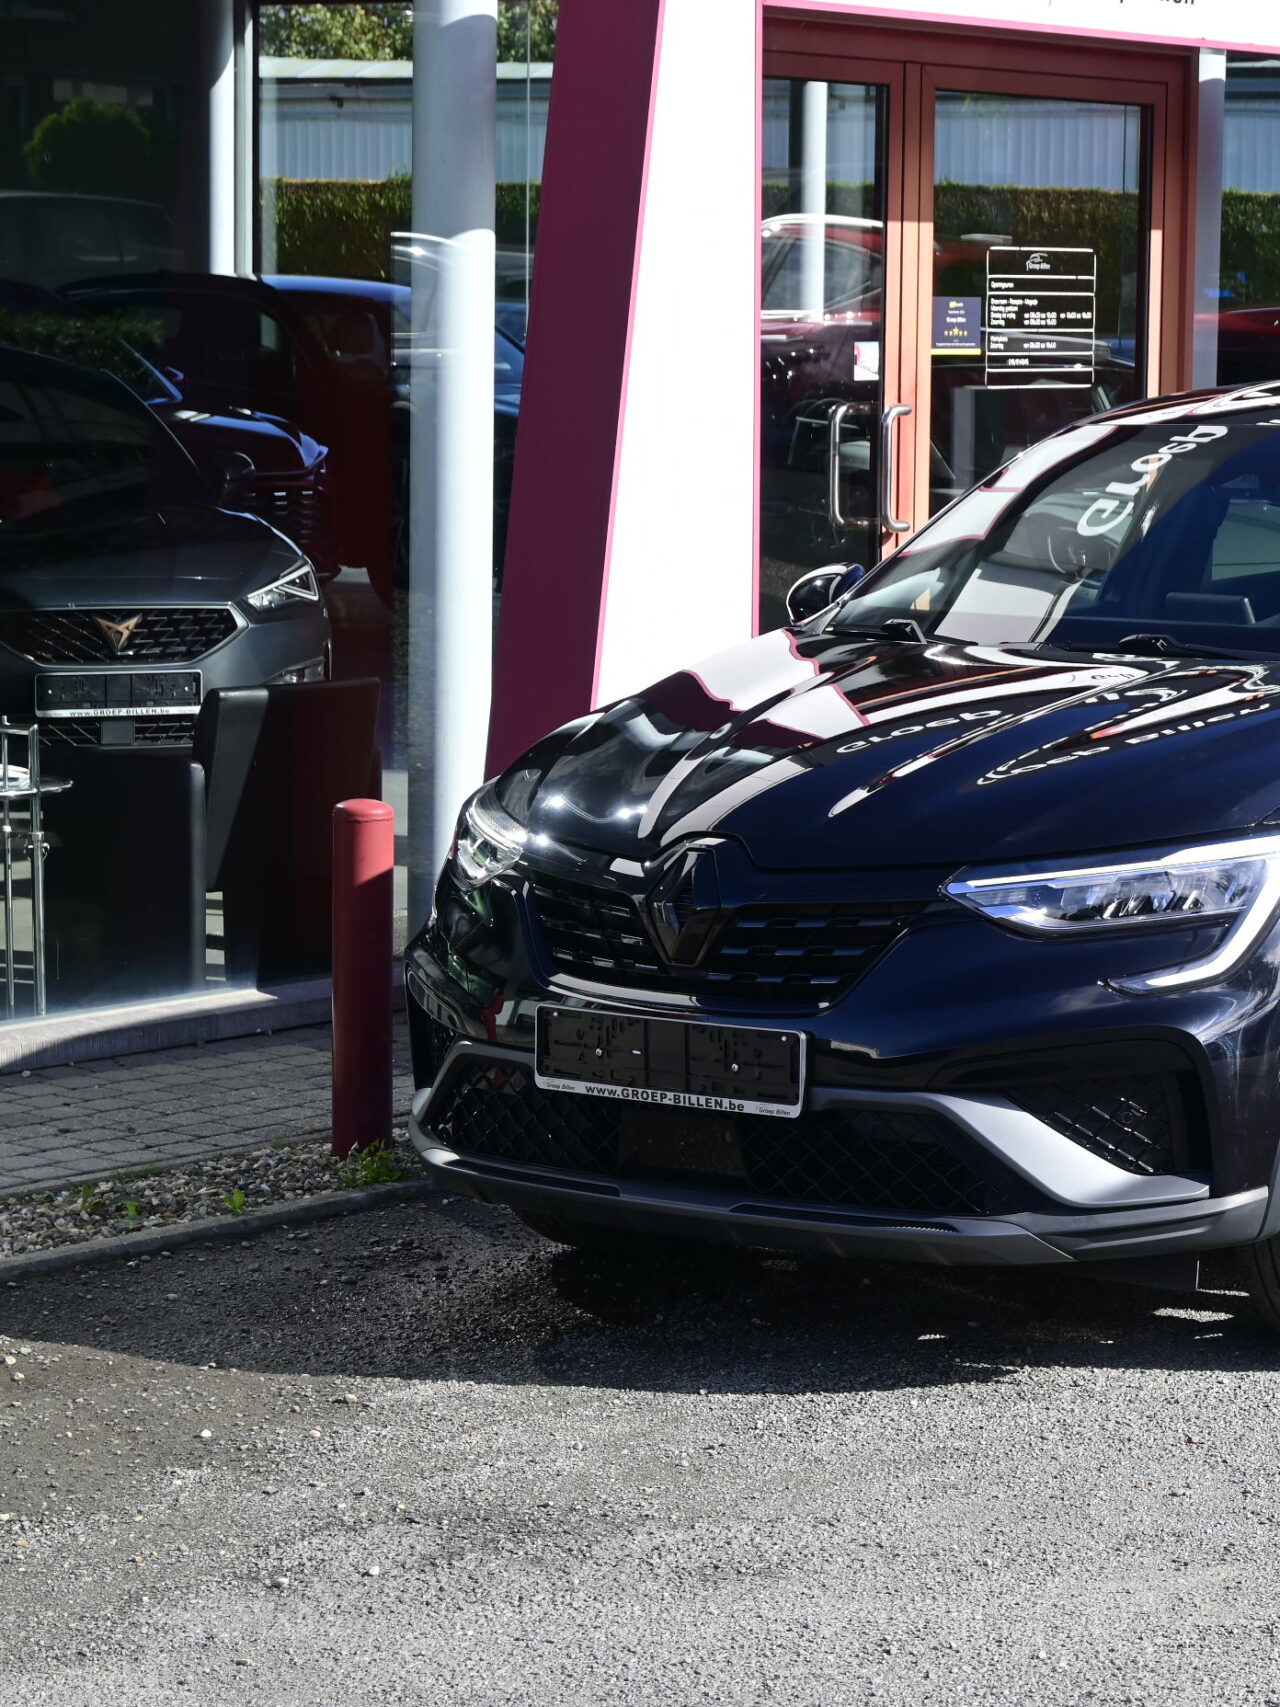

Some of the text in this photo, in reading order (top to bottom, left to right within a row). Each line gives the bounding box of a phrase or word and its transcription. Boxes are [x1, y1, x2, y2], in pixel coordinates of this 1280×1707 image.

[585, 1085, 745, 1112] www.GROEP-BILLEN.be
[759, 1106, 791, 1116] Groep Billen
